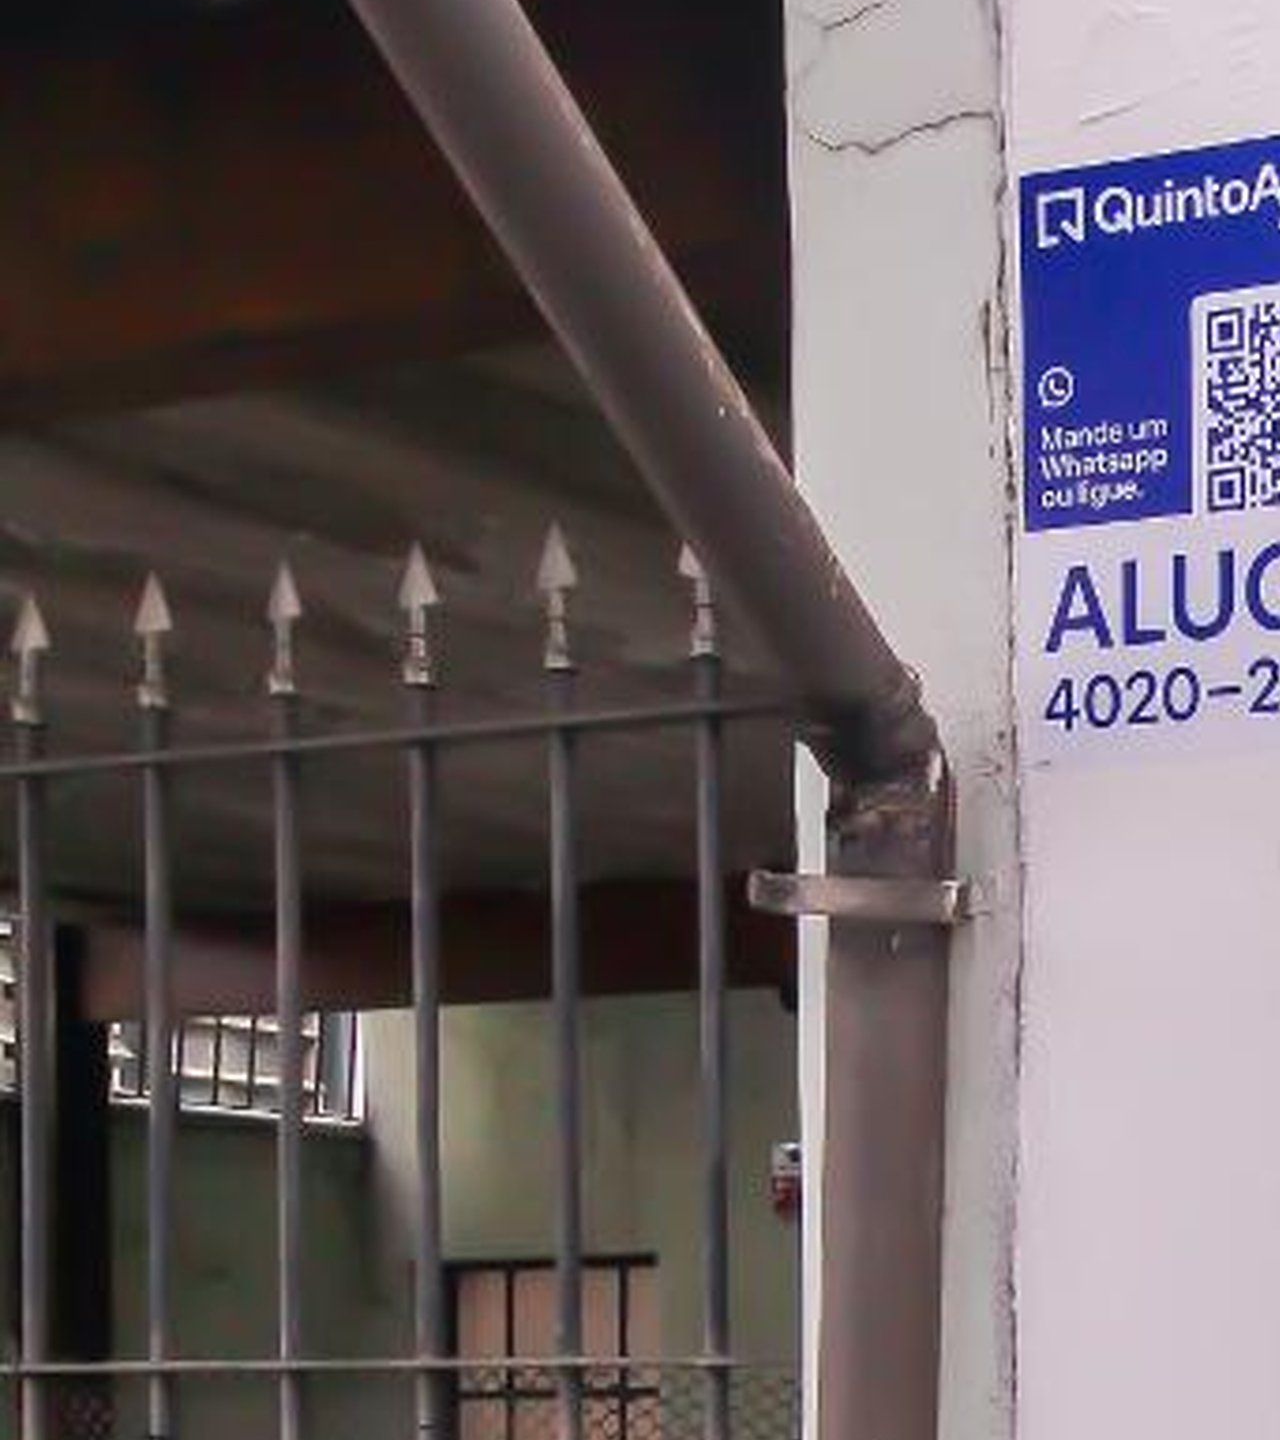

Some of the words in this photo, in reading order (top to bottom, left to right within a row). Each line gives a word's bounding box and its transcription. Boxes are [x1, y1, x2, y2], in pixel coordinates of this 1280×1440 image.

[1040, 422, 1123, 451] Mande
[1127, 418, 1168, 440] um
[1039, 448, 1169, 481] Whatsapp
[1041, 488, 1074, 508] ou
